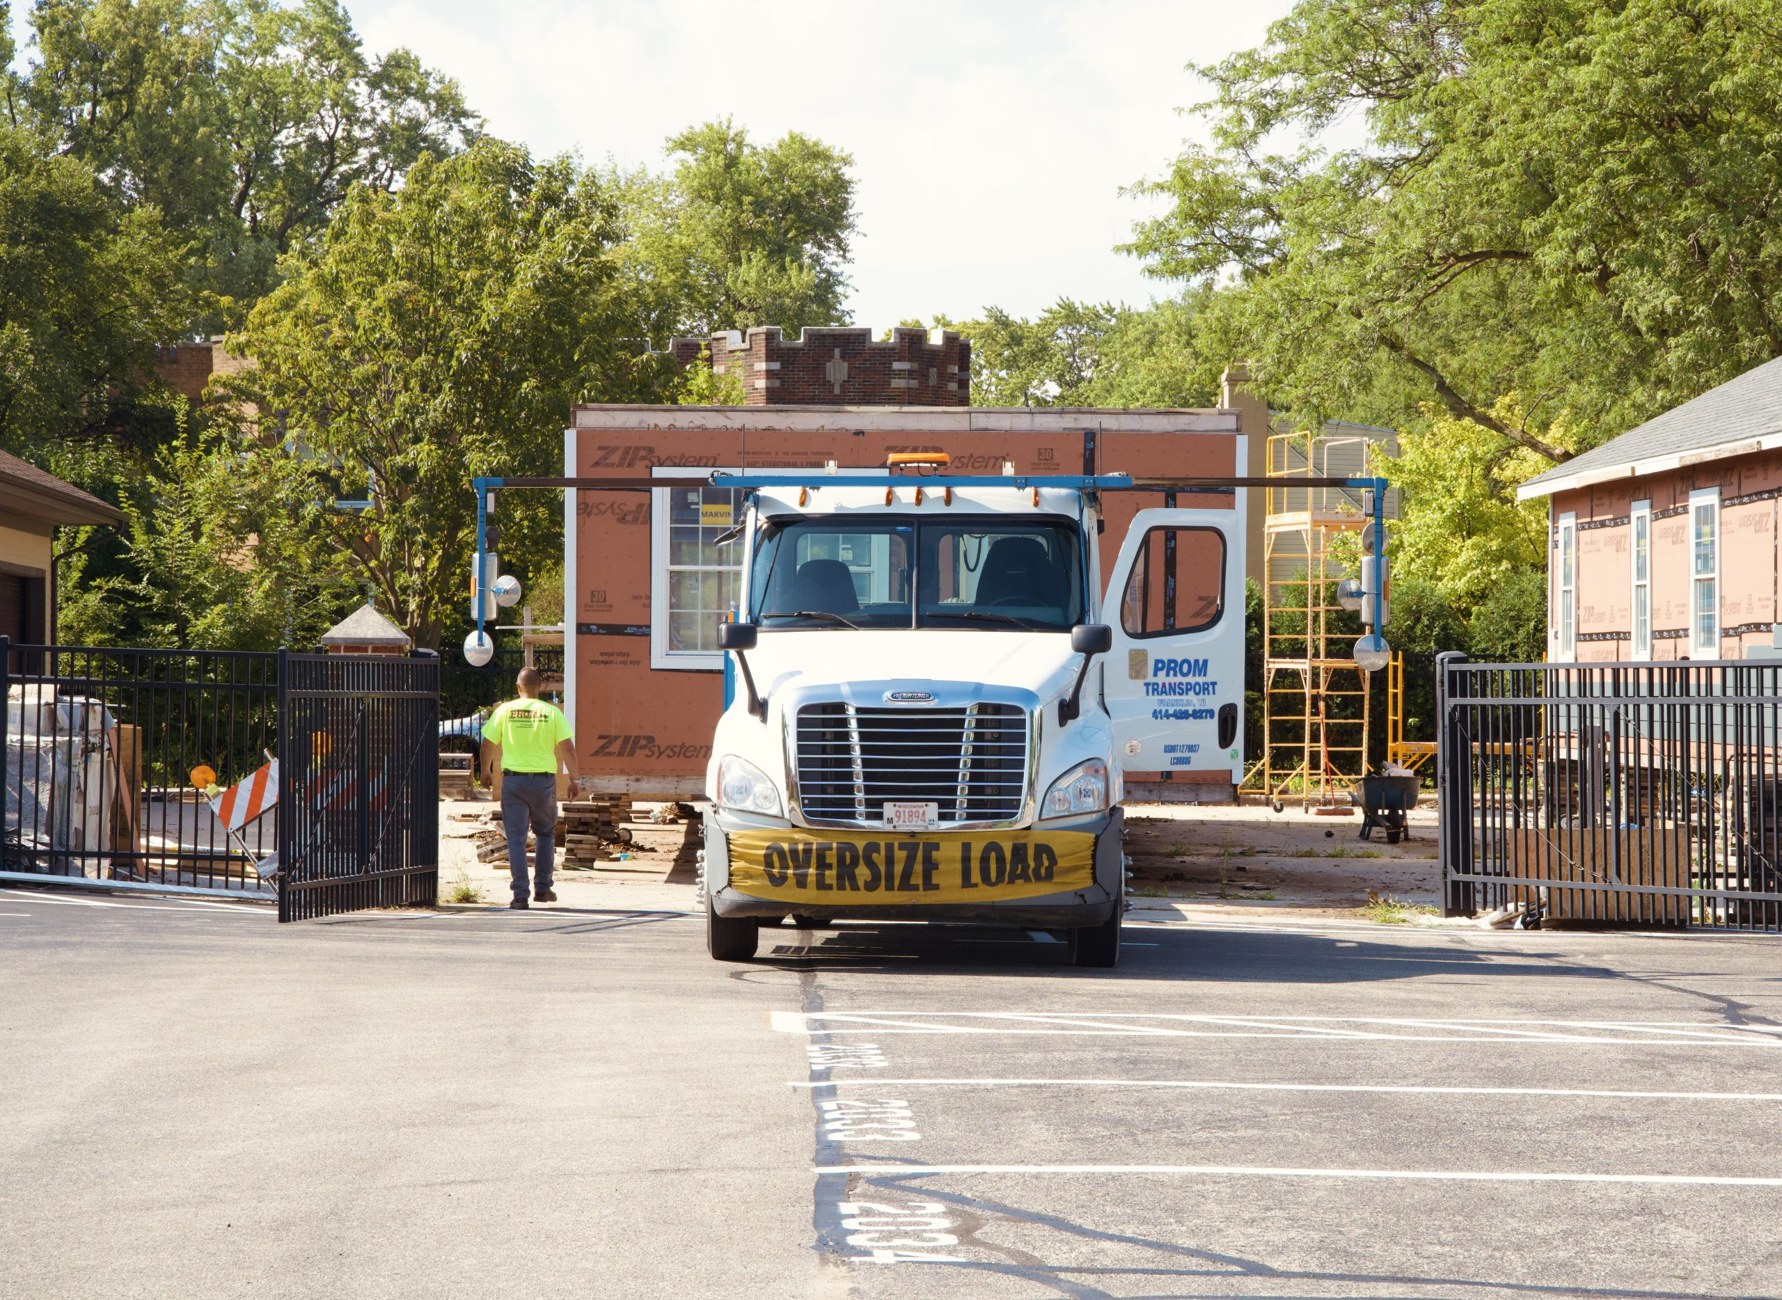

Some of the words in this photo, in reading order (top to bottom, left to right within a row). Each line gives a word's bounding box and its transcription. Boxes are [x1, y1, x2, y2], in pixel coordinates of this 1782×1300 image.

[592, 591, 605, 602] 30
[1153, 659, 1209, 678] PROM
[1144, 682, 1217, 696] TRANSPORT
[895, 809, 926, 823] 91894
[762, 841, 940, 893] OVERSIZE
[961, 841, 1058, 889] LOAD
[820, 1099, 921, 1141] 2033
[837, 1201, 967, 1264] 2034
